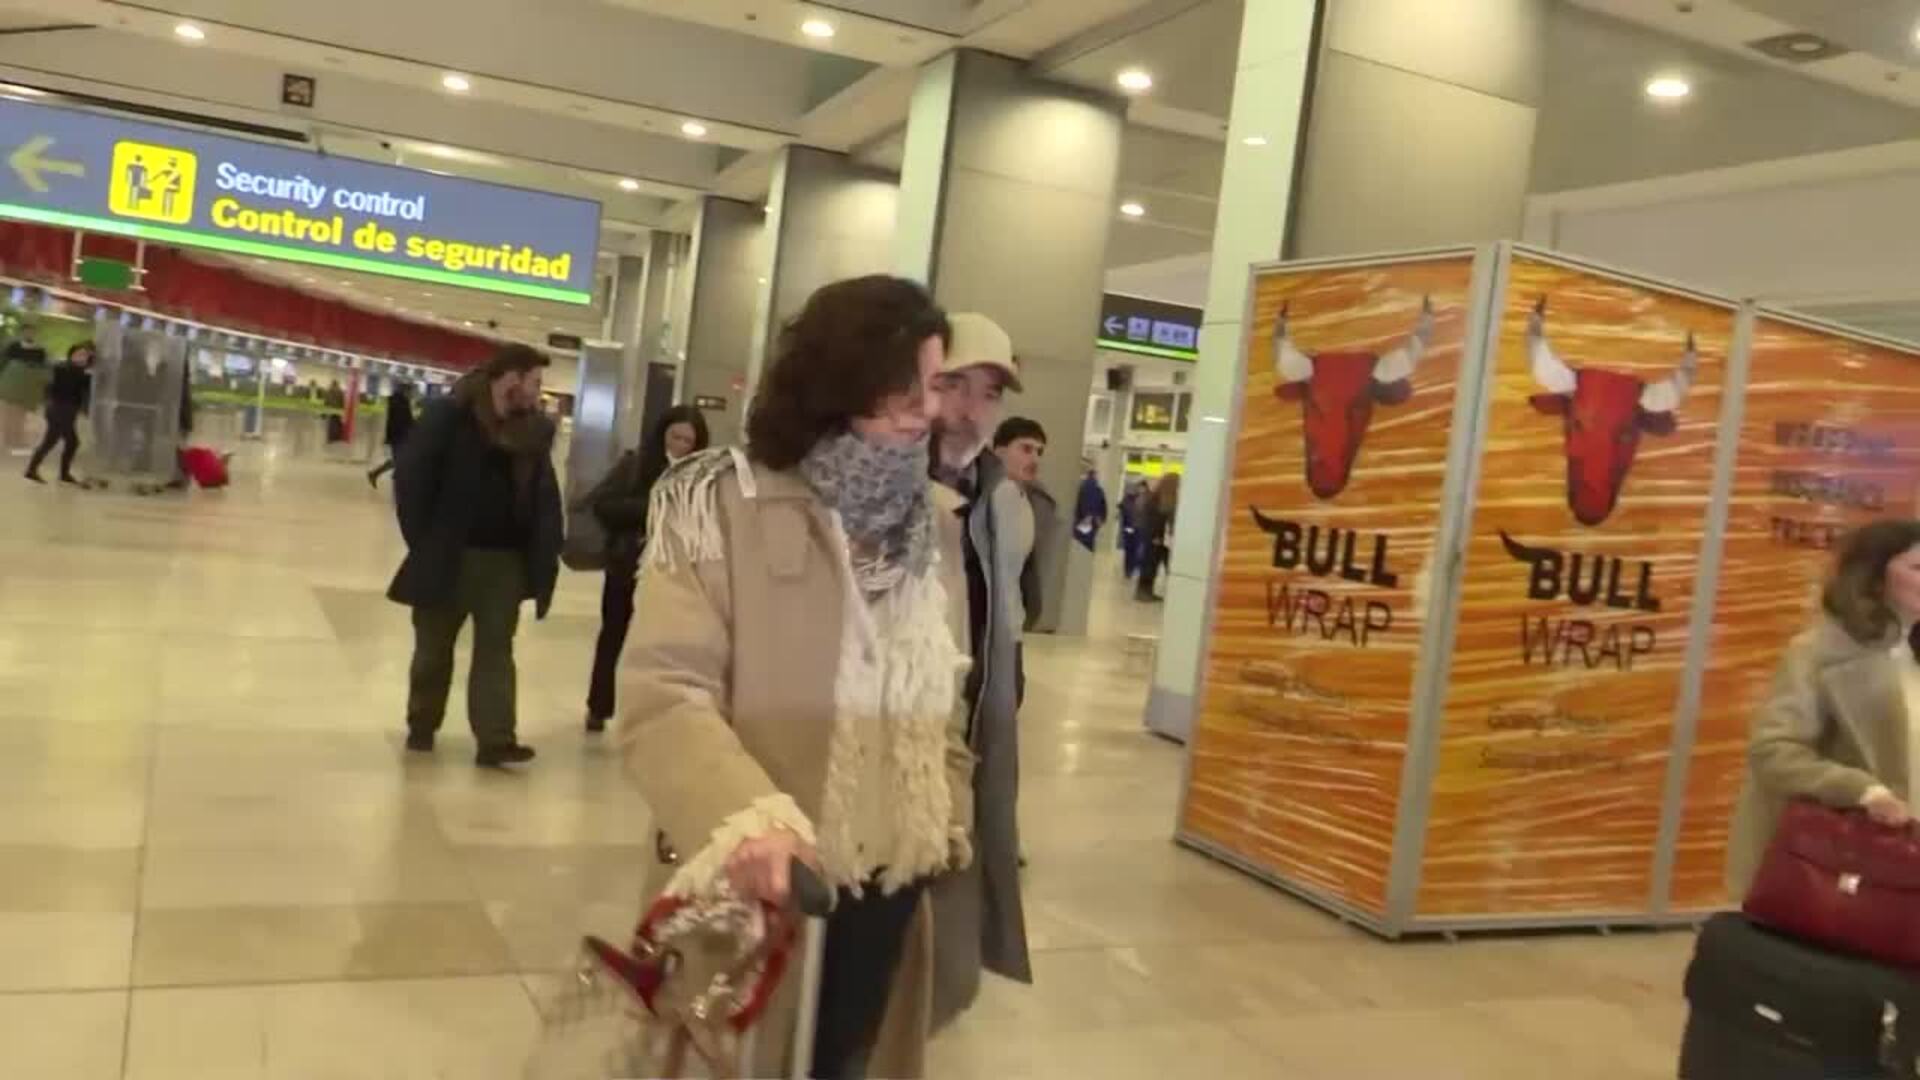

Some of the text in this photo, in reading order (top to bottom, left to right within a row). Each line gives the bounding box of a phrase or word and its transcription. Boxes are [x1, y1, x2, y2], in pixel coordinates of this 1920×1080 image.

[215, 161, 425, 221] Security control
[211, 197, 572, 281] Control de seguridad
[1250, 504, 1398, 588] BULL
[1500, 529, 1661, 613] BULL
[1265, 580, 1394, 648] WRAP
[1520, 613, 1658, 672] WRAP
